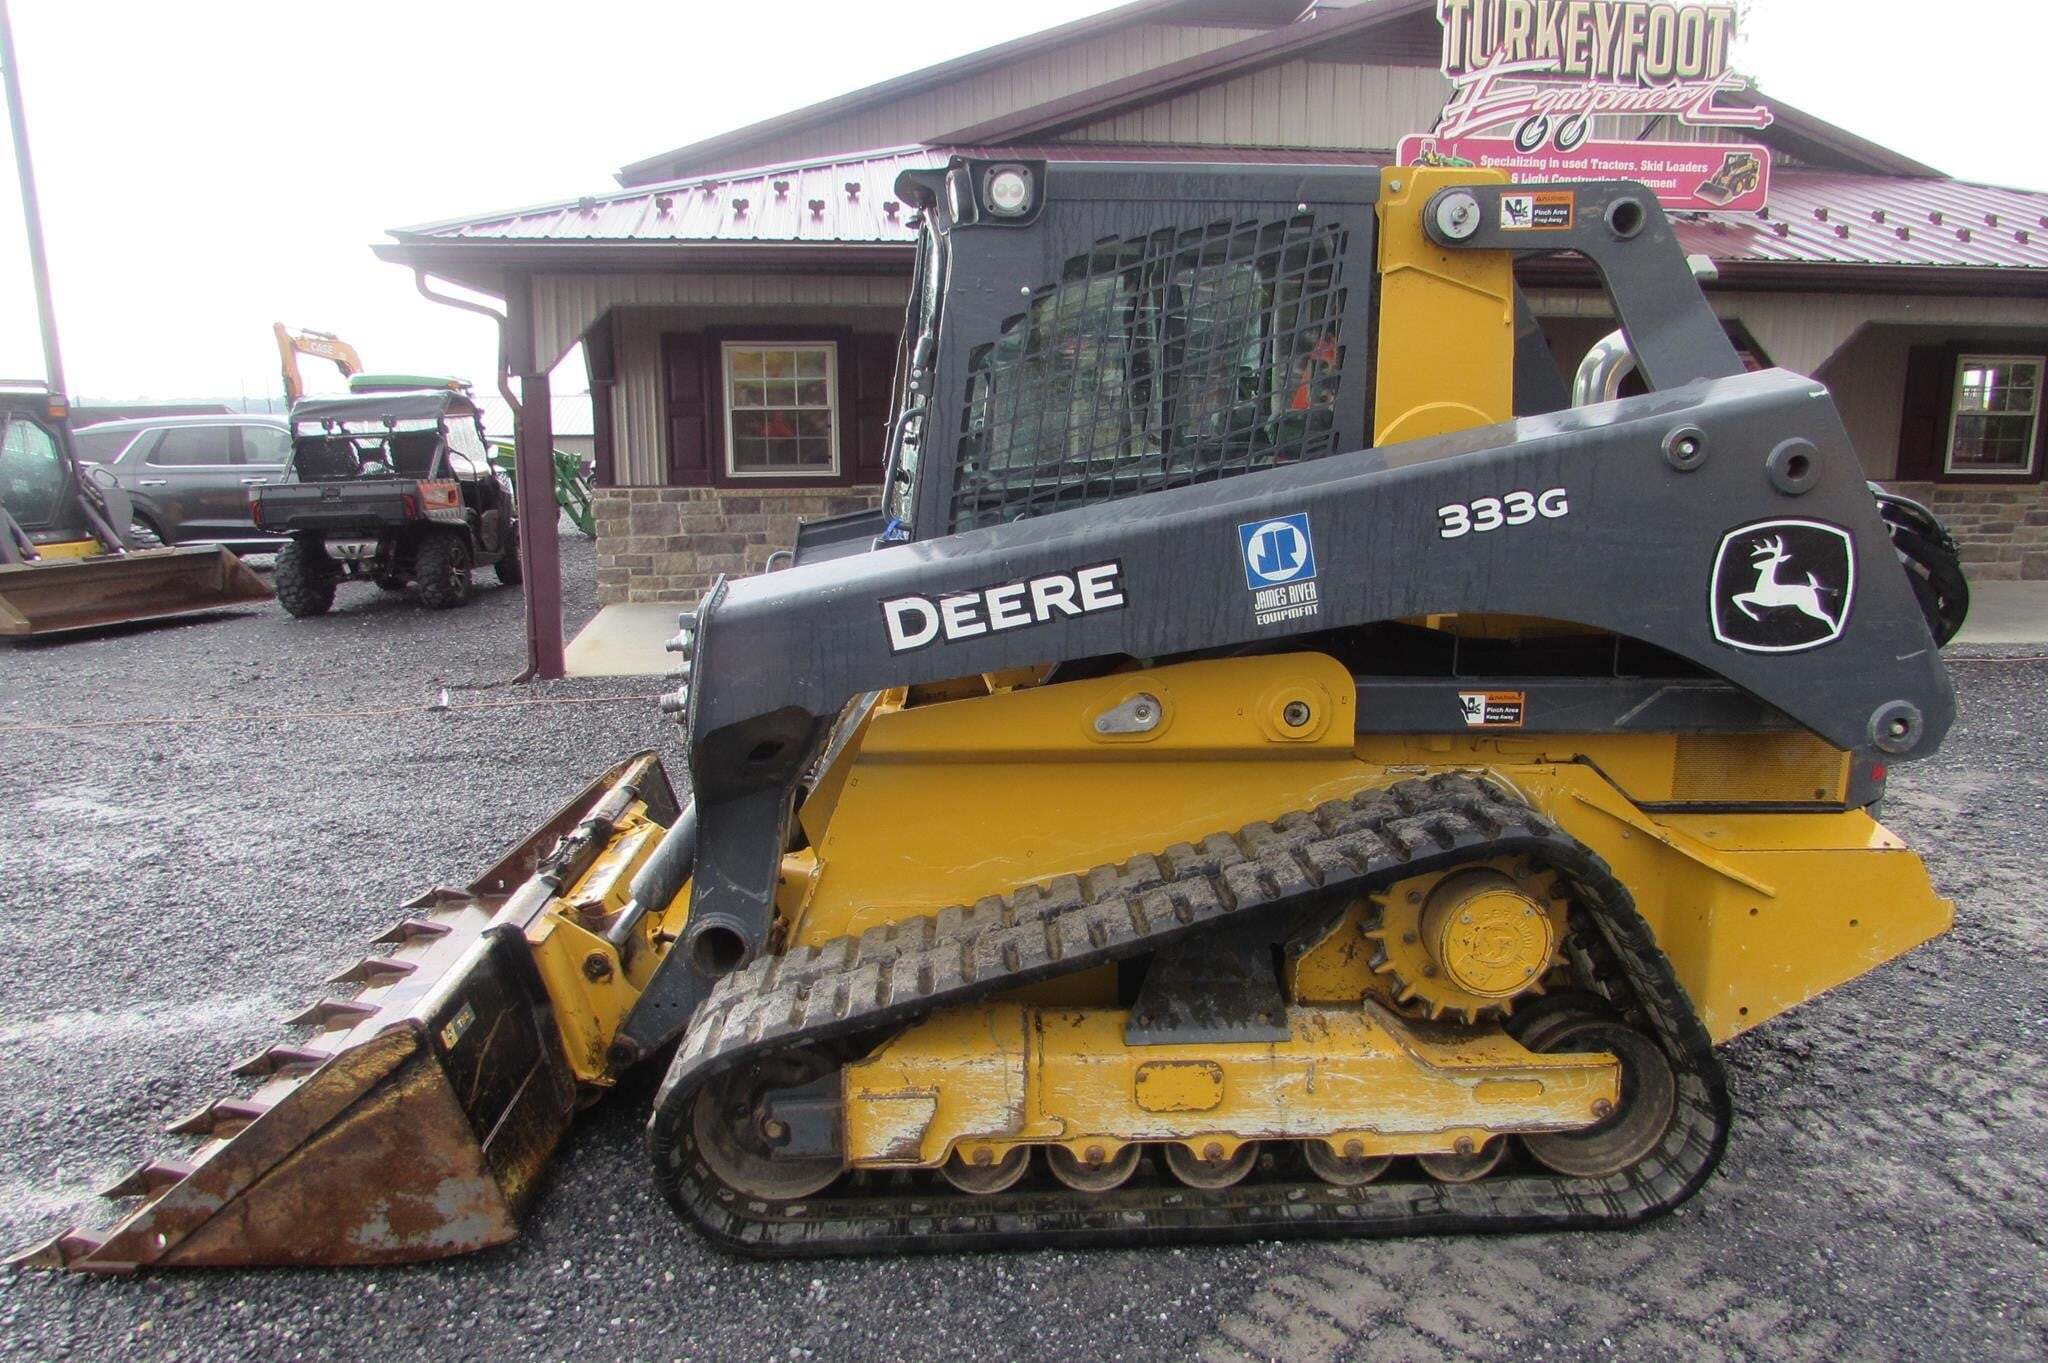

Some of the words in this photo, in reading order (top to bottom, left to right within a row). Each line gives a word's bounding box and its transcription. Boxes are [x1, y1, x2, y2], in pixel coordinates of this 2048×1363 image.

[1444, 0, 1736, 78] TURKEYFOOT
[1441, 48, 1766, 138] Equipment
[1480, 154, 1547, 170] Specializing
[1548, 157, 1560, 169] in
[1562, 158, 1588, 170] used
[1641, 160, 1664, 172] Skid
[1666, 161, 1708, 173] Loaders
[1521, 173, 1550, 185] Light
[1620, 176, 1677, 189] ipment
[1534, 208, 1552, 216] Pinch
[1552, 208, 1568, 216] Area
[1438, 488, 1569, 538] 333G
[883, 564, 1124, 651] DEERE
[1254, 586, 1288, 611] JAMES
[1288, 581, 1317, 605] RIVER
[1256, 603, 1319, 626] EQUIPMENT
[1486, 706, 1504, 714] Pinch
[1504, 706, 1520, 714] Area
